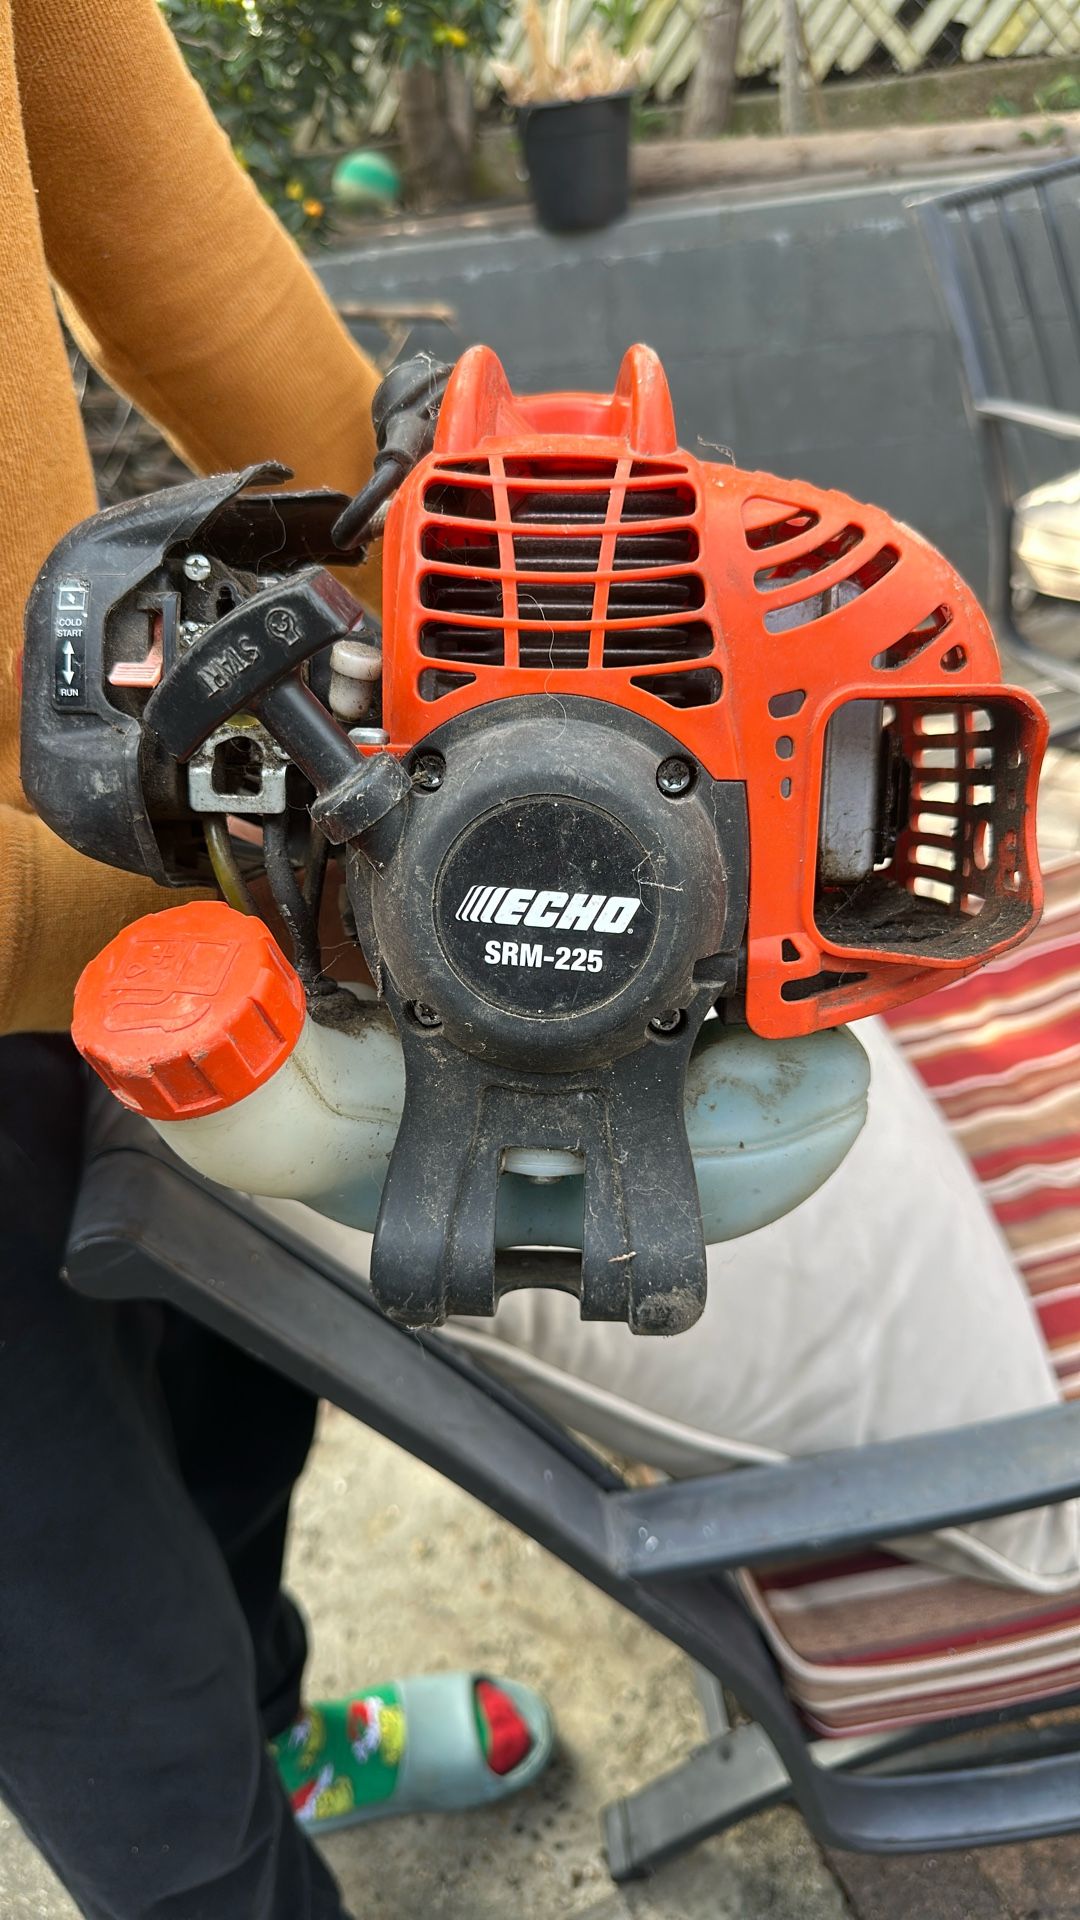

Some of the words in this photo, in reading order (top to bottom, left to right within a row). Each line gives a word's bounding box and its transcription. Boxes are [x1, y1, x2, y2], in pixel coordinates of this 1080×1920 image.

[59, 618, 82, 627] COLD
[57, 629, 83, 637] START
[60, 688, 79, 697] RUN
[493, 888, 641, 934] ECHO
[484, 940, 603, 973] SRM-225
